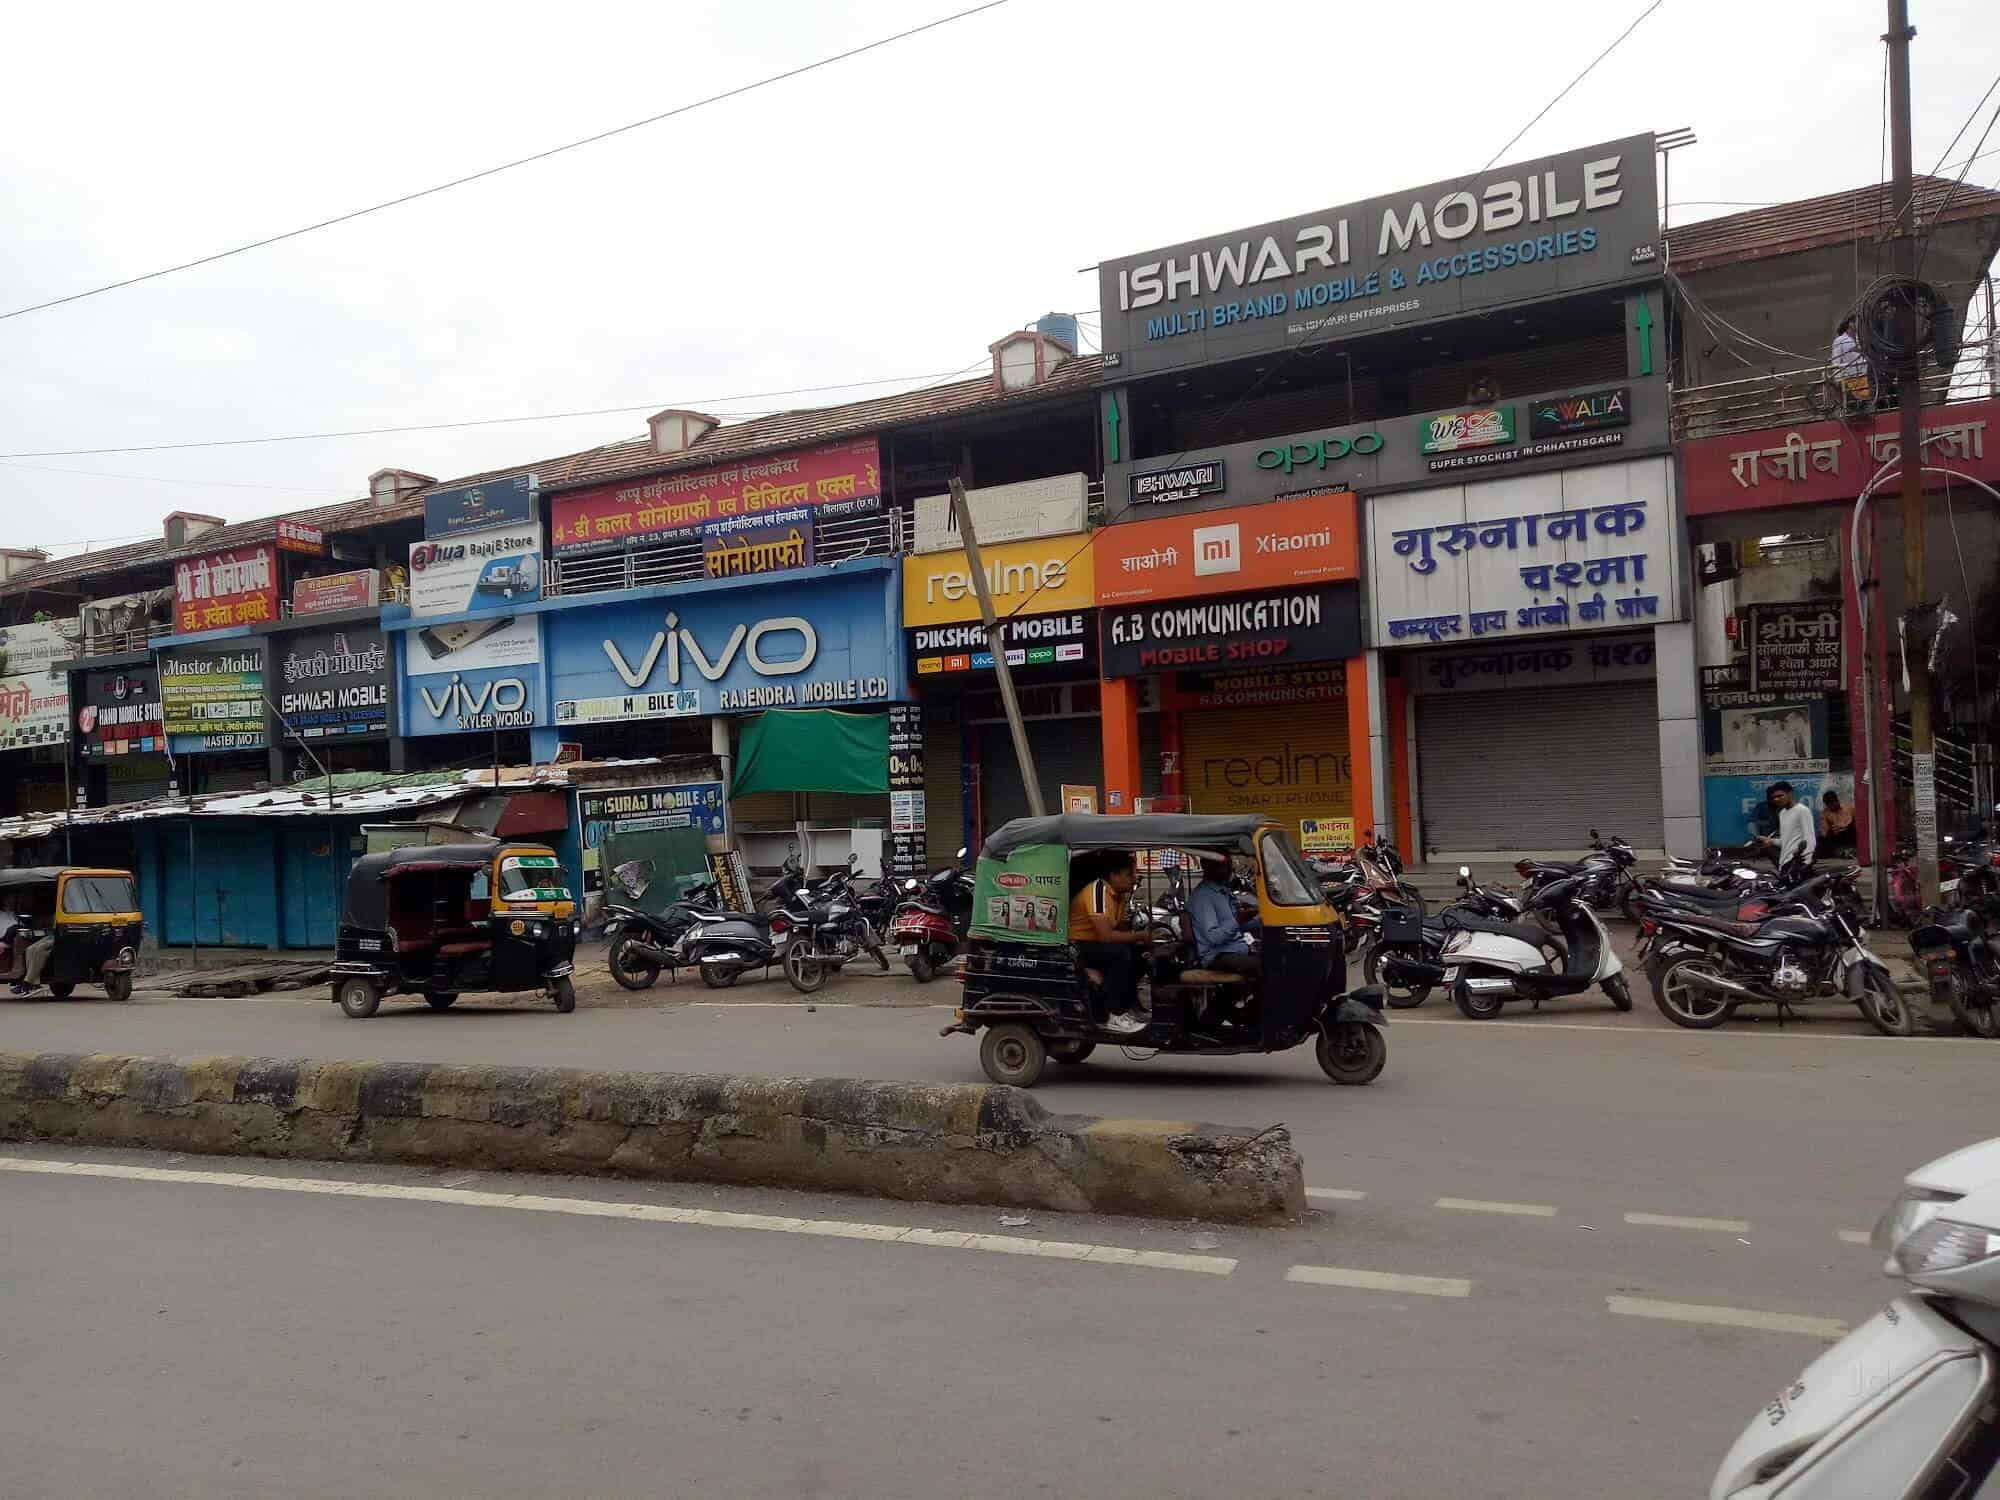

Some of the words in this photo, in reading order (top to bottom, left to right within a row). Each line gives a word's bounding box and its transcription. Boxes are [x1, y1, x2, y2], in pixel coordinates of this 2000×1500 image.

[1119, 218, 1350, 311] ISHWARI
[1378, 155, 1624, 256] MOBILE
[1147, 307, 1209, 341] MULTI
[1212, 292, 1288, 329] BRAND
[1294, 270, 1380, 310] MOBILE
[1388, 267, 1406, 290] &
[1416, 226, 1598, 287] ACCESSORIES
[1349, 300, 1421, 322] ENTERPRISES
[1430, 456, 1465, 471] SUPER
[1467, 450, 1519, 466] STOCKIST
[1523, 446, 1533, 457] IN
[1535, 433, 1622, 453] CHHATTISGARH
[1729, 432, 1843, 488] राजीव
[1137, 466, 1214, 493] ISHWARI
[595, 512, 633, 533] कलर
[638, 494, 711, 529] सोनोग्राफी
[718, 490, 737, 515] एवं
[742, 481, 809, 510] डिजिटल
[1152, 487, 1200, 504] MOBILE
[503, 535, 533, 549] Store
[1256, 527, 1332, 554] Xiaomi
[1392, 500, 1647, 576] गुरुनानक
[705, 527, 806, 578] सोनोग्राफी
[1120, 547, 1178, 575] शाओमी
[1519, 554, 1648, 592] चश्मा
[1112, 614, 1144, 645] A.B
[1151, 594, 1321, 640] COMMUNICATION
[1578, 592, 1606, 621] की
[915, 623, 1008, 650] DIKSHAT
[1012, 615, 1084, 641] MOBILE
[1140, 644, 1220, 667] MOBILE
[1227, 639, 1290, 659] SHOP
[164, 659, 213, 676] Master
[281, 689, 335, 713] ISHWARI
[338, 685, 388, 708] MOBILE
[720, 685, 796, 709] RAJENDRA
[802, 680, 857, 704] MOBILE
[859, 677, 888, 699] LCD
[457, 712, 492, 729] SKYLER
[495, 710, 534, 726] WORLD
[203, 734, 236, 749] MASTER
[606, 794, 649, 814] SURAJ
